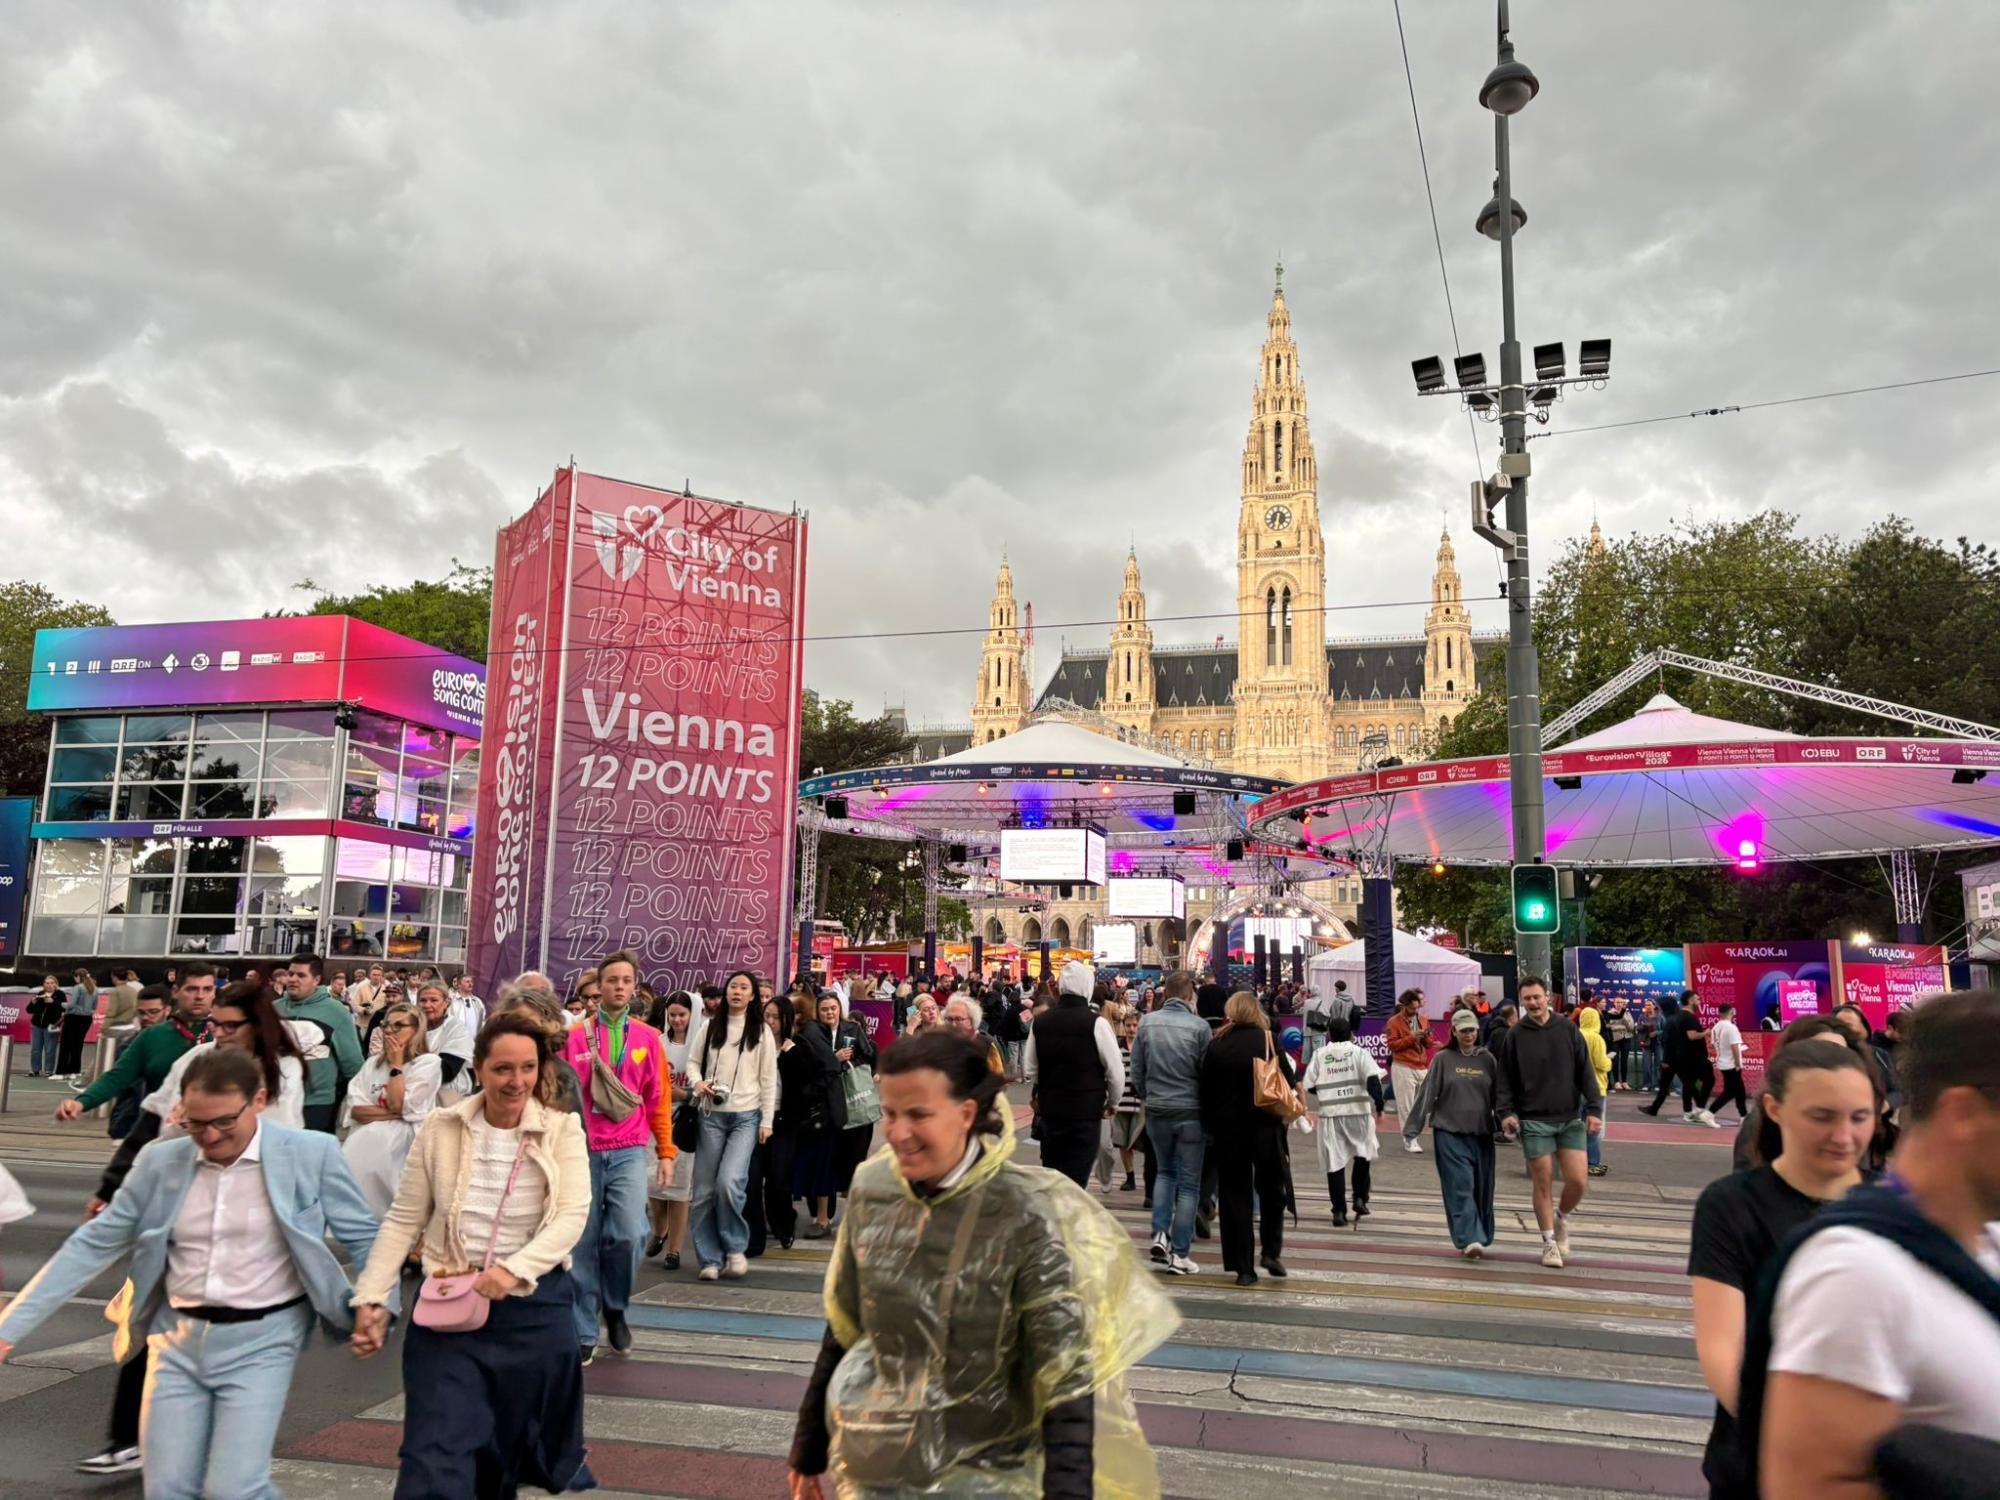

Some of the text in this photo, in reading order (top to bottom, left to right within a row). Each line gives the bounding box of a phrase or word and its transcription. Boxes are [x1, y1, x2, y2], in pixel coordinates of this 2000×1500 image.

[665, 528, 778, 573] City of
[666, 561, 782, 608] Vienna
[587, 606, 780, 664] 12 POINTS
[584, 646, 780, 703] 12 POINTS
[582, 688, 774, 757] Vienna
[1586, 750, 1672, 762] Eurovision Village
[1645, 757, 1669, 765] 2026
[1859, 749, 1884, 758] ORF
[1916, 748, 1930, 756] City
[578, 754, 774, 803] 12 POINTS
[1419, 772, 1436, 780] ORF
[574, 796, 773, 844] 12 POINTS
[572, 838, 771, 884] 12 POINTS
[569, 882, 768, 924] 12 POINTS
[566, 924, 766, 964] 12 POINTS
[1710, 968, 1725, 976] City
[1859, 984, 1880, 994] City of
[1860, 994, 1882, 1002] Vienna
[1886, 980, 1944, 992] Vienna Vienna
[1327, 1064, 1354, 1074] Steward
